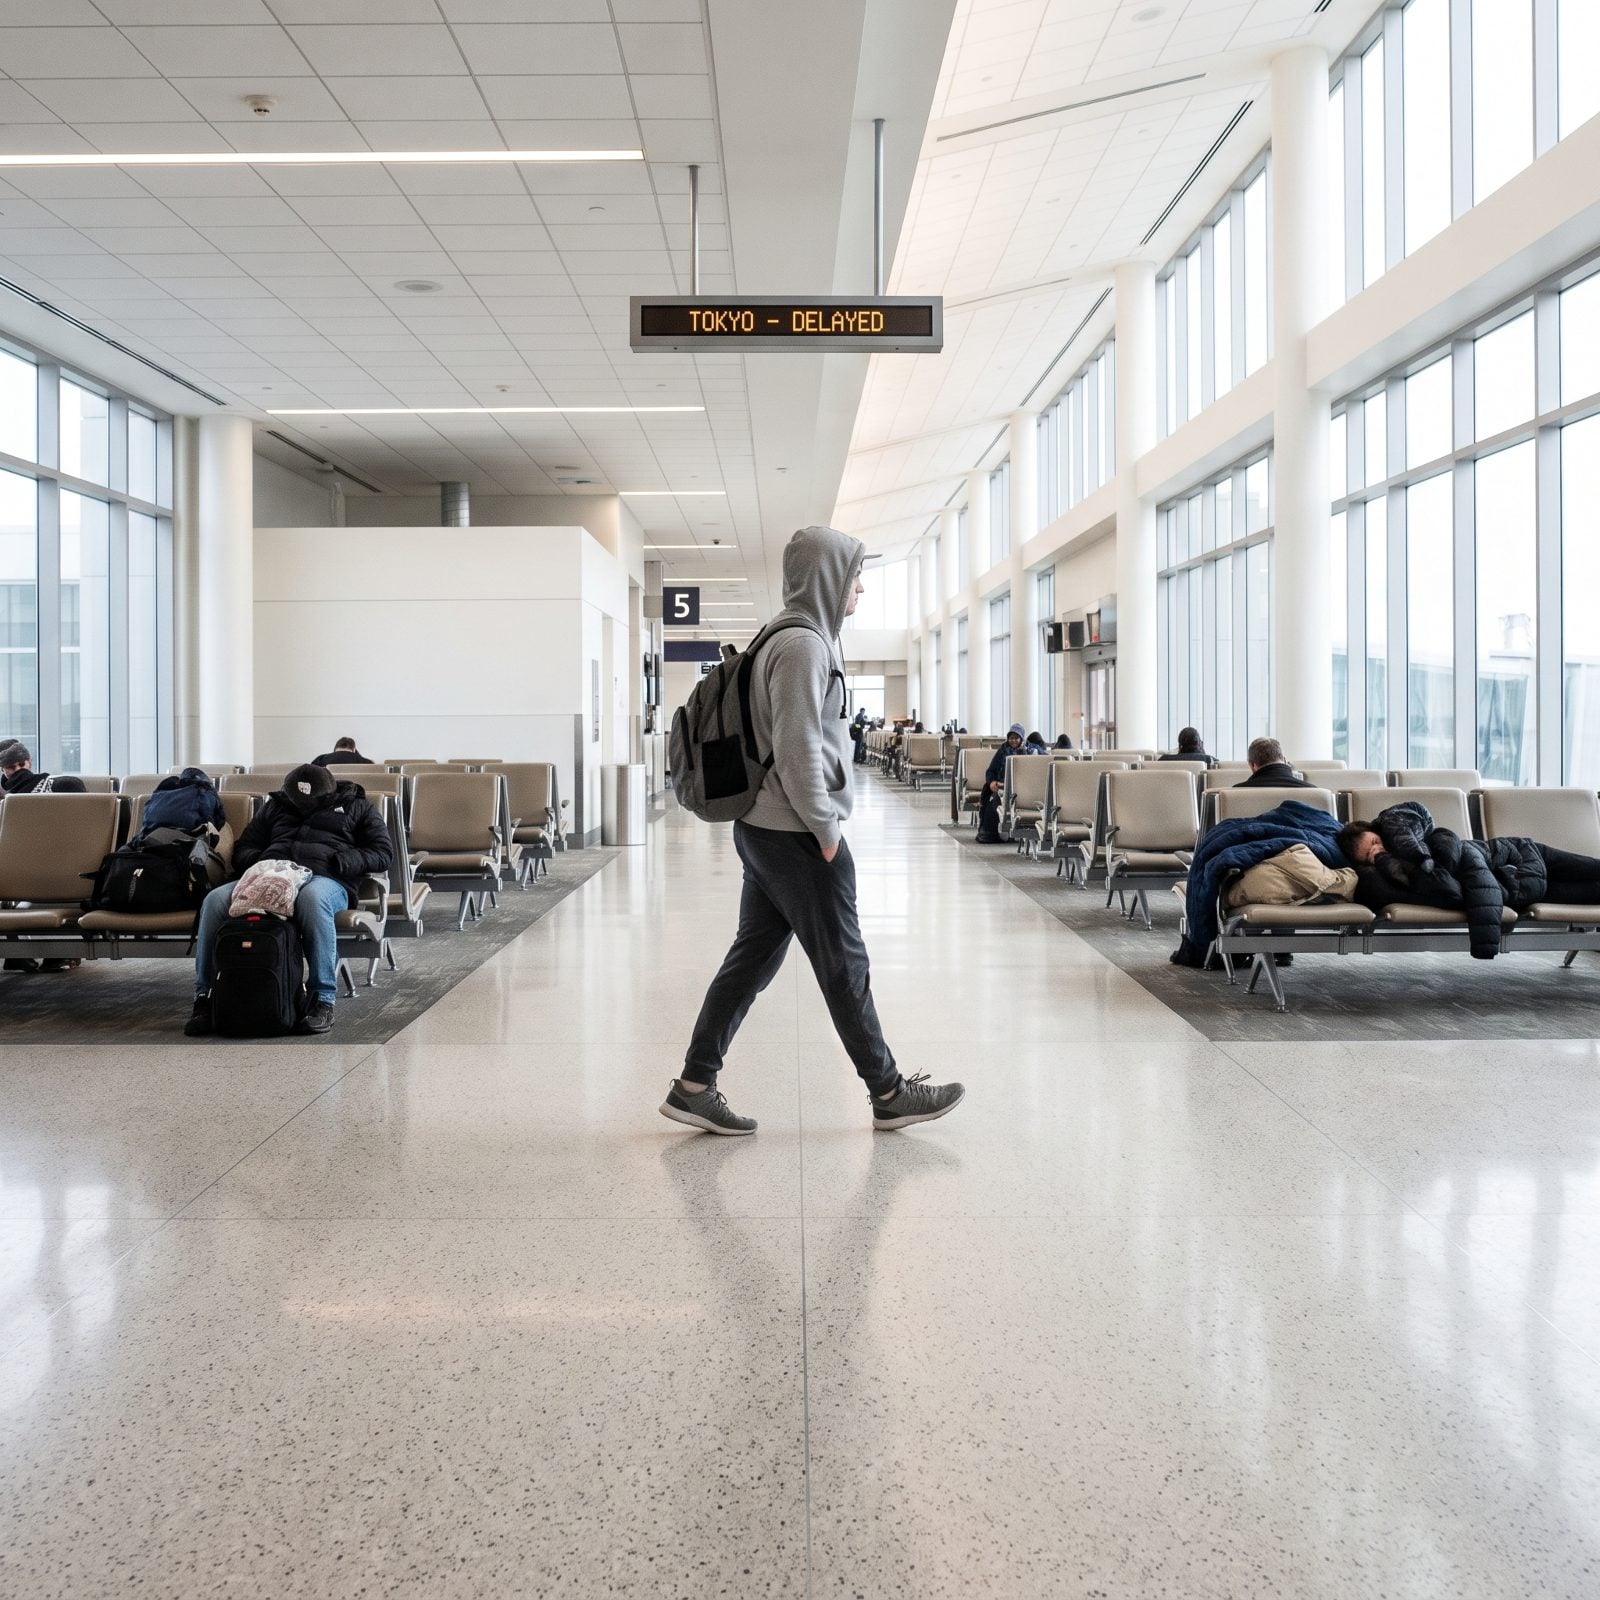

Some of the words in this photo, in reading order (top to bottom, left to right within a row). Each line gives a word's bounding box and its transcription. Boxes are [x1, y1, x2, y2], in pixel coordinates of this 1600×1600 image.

[689, 310, 754, 332] TOKYO
[792, 310, 884, 332] DELAYED
[674, 593, 690, 618] 5
